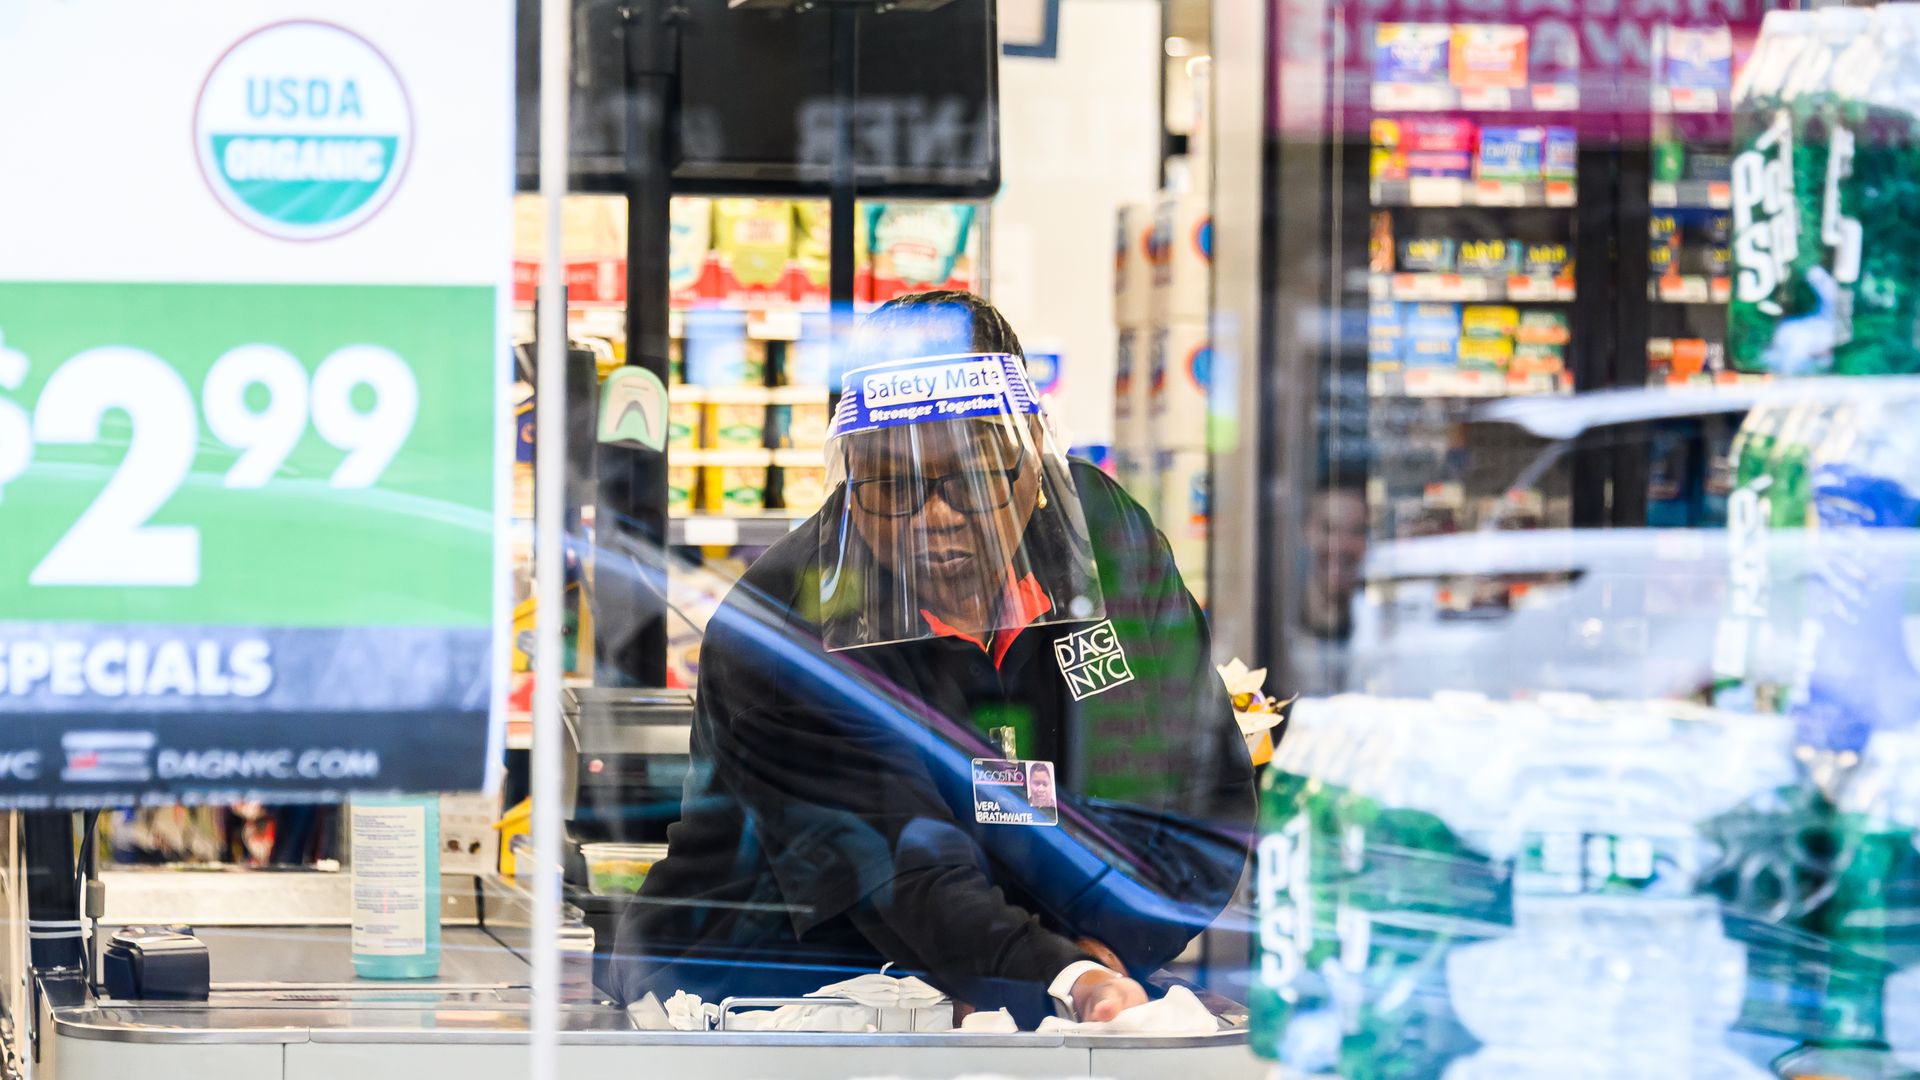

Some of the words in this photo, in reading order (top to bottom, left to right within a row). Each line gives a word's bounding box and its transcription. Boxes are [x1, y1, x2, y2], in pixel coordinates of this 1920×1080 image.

[245, 77, 363, 119] USDA
[223, 137, 386, 182] ORGANIC
[866, 375, 937, 400] Safety
[945, 367, 999, 390] Mate
[868, 404, 934, 422] Stronger
[1056, 628, 1115, 668] D'AG
[0, 639, 273, 697] PECIALS
[1068, 653, 1127, 695] NYC
[157, 748, 381, 781] DAGNYC.COM
[976, 801, 1001, 811] VERA
[976, 811, 1033, 823] BRATHWAITE
